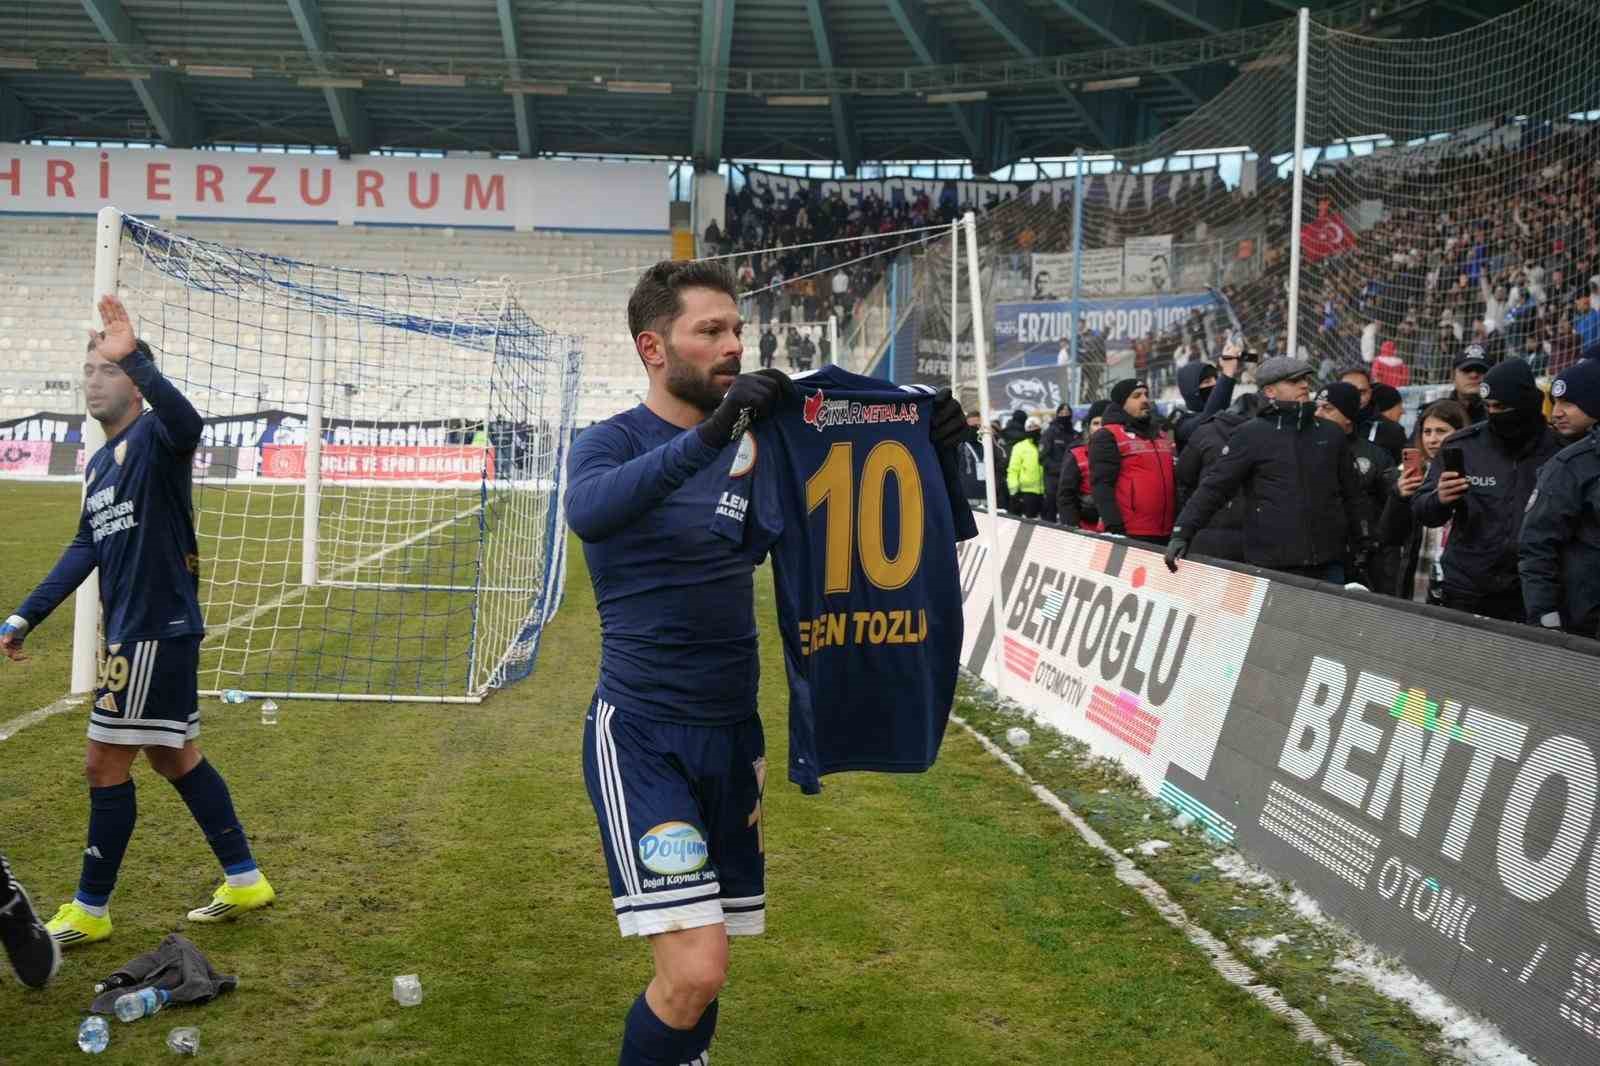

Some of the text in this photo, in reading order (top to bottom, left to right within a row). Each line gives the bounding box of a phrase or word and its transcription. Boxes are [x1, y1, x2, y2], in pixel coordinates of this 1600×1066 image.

[146, 162, 506, 212] ERZURUM
[805, 439, 925, 594] 10
[1277, 655, 1600, 935] BENTO
